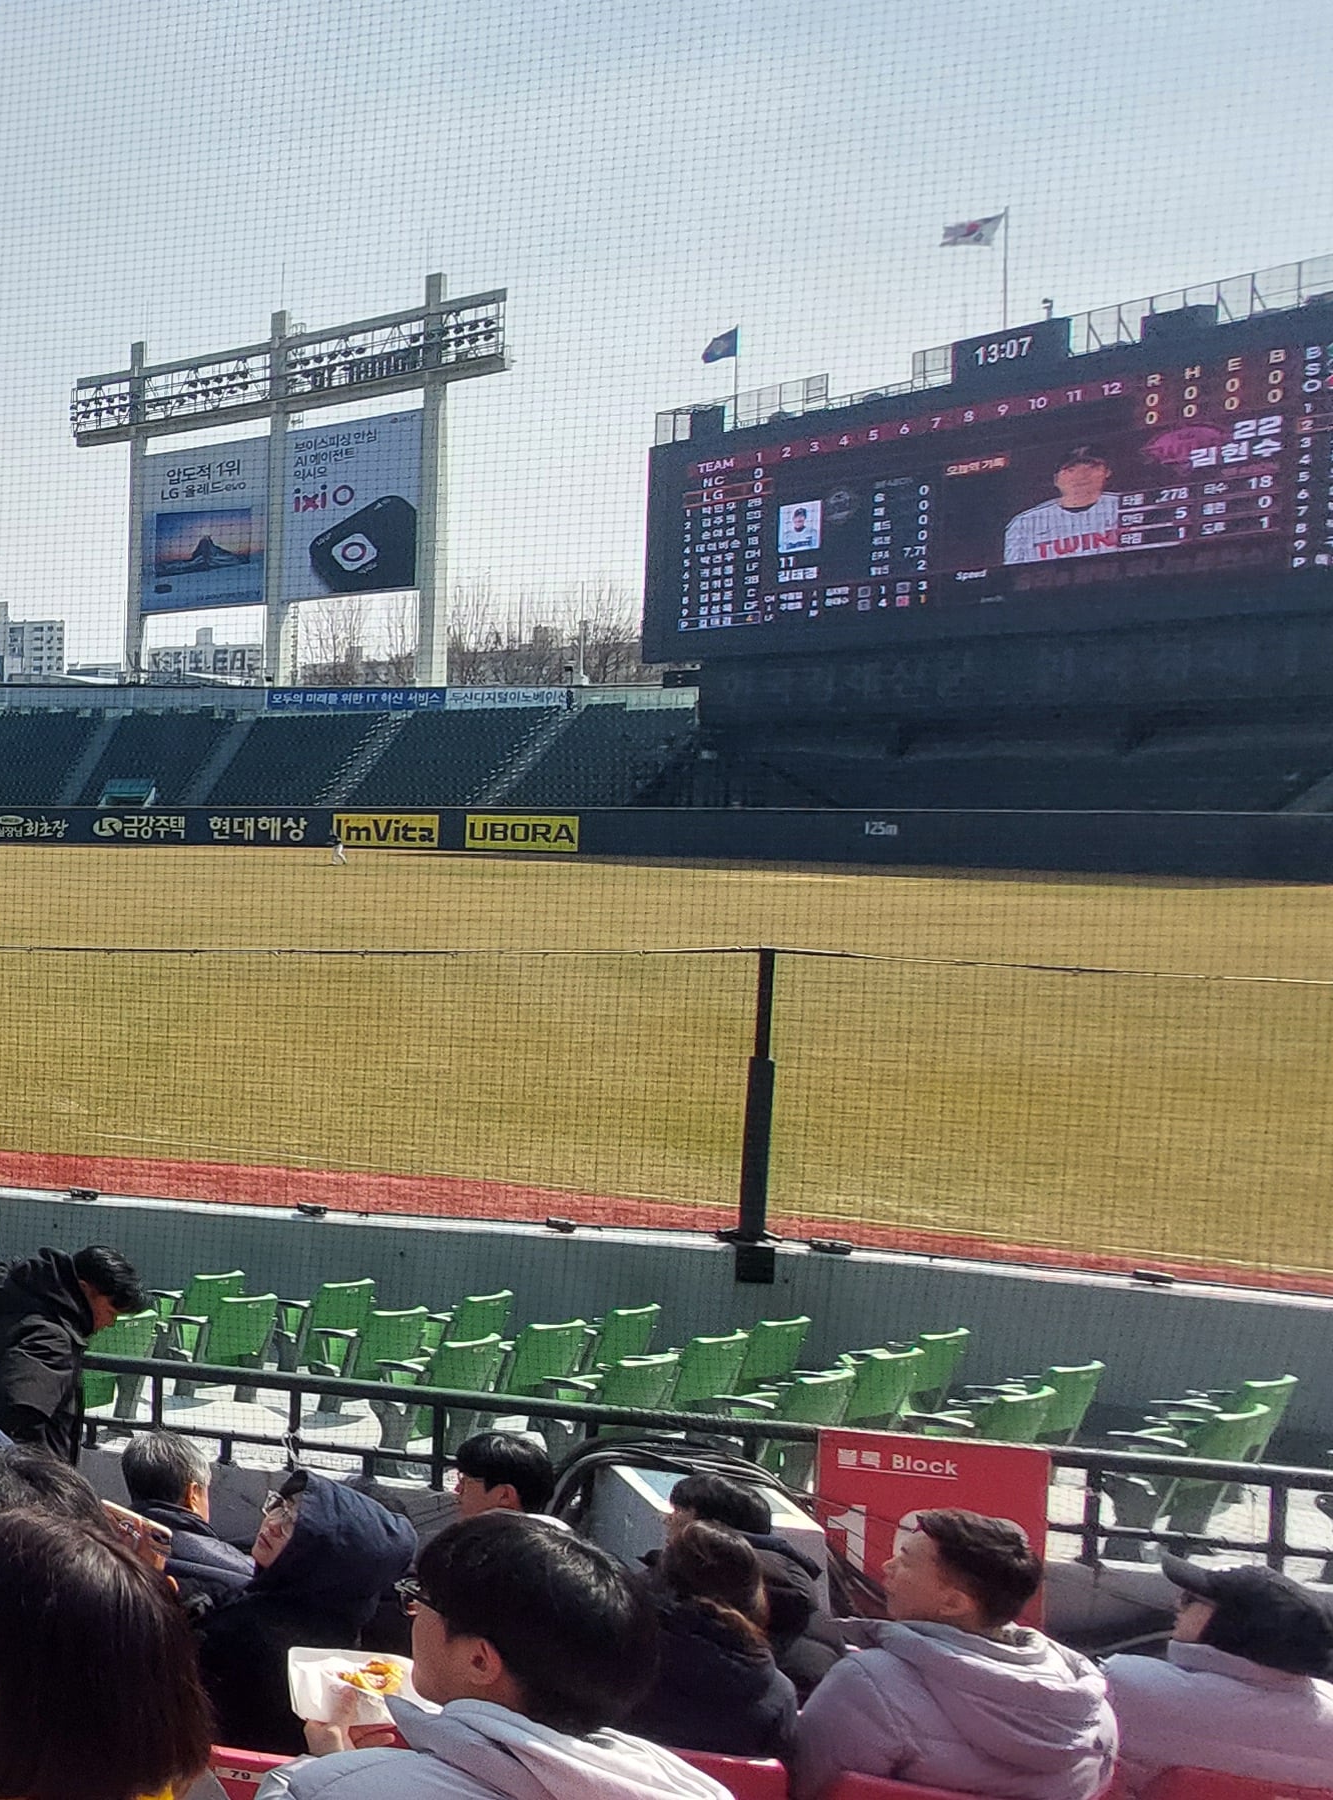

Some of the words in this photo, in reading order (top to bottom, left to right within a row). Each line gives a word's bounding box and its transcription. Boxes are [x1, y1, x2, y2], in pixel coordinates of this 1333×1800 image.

[974, 336, 1032, 366] 13:07
[1306, 346, 1322, 361] B
[1304, 362, 1321, 376] S
[1145, 393, 1159, 407] 0
[1184, 386, 1198, 400] 0
[1225, 378, 1240, 393] 0
[1268, 370, 1283, 385] 0
[1302, 378, 1322, 393] O
[697, 458, 735, 474] TEAM
[755, 452, 762, 462] 1
[781, 446, 792, 457] 2
[810, 441, 819, 452] 3
[838, 435, 849, 446] 4
[868, 430, 878, 441] 5
[899, 424, 910, 435] 6
[931, 417, 941, 429] 7
[963, 411, 974, 422] 8
[997, 404, 1008, 416] 9
[1028, 397, 1048, 410] 10
[1066, 390, 1082, 403] 11
[1102, 382, 1123, 396] 12
[1147, 373, 1162, 387] R
[1184, 366, 1201, 379] H
[1228, 357, 1242, 371] E
[1269, 349, 1285, 364] B
[1233, 415, 1282, 441] 22
[293, 433, 351, 453] 보이스피싱
[352, 429, 379, 444] 안심
[703, 490, 724, 502] LG
[754, 482, 763, 494] 0
[1145, 411, 1158, 424] 0
[1183, 404, 1197, 418] 0
[1225, 396, 1239, 411] 0
[1267, 389, 1282, 403] 0
[1300, 437, 1312, 449] 3
[293, 455, 307, 468] AI
[309, 447, 356, 465] 에이전트
[1190, 437, 1282, 469] 김현수
[1299, 454, 1311, 465] 4
[165, 463, 213, 486] 압도적
[216, 459, 241, 478] 1위
[293, 466, 328, 481] 익시오
[1298, 471, 1310, 482] 5
[161, 487, 179, 501] LG
[918, 485, 929, 496] 0
[1155, 487, 1190, 504] .278
[1248, 475, 1274, 490] 18
[1296, 488, 1309, 500] 6
[918, 500, 928, 511] 0
[1175, 506, 1188, 520] 5
[1258, 495, 1272, 509] 0
[1296, 505, 1309, 516] 7
[917, 514, 928, 526] 0
[1177, 527, 1185, 539] 1
[1259, 516, 1270, 529] 1
[1295, 523, 1307, 534] 8
[917, 530, 928, 541] 0
[1294, 539, 1307, 551] 9
[779, 556, 795, 569] 11
[916, 560, 927, 571] 2
[1292, 556, 1306, 568] P
[955, 568, 988, 582] Speed
[746, 588, 757, 597] C
[918, 581, 928, 591] 3
[271, 693, 303, 704] 모두의
[305, 692, 339, 704] 미래를
[340, 692, 364, 704] 위한
[366, 693, 379, 703] IT
[410, 692, 441, 706] 서비스
[123, 816, 186, 839] 금강주택
[208, 816, 309, 842] 현대해상
[469, 822, 576, 845] UBORA
[864, 820, 899, 836] 125m
[891, 1453, 959, 1476] Block
[230, 1769, 251, 1780] 79
